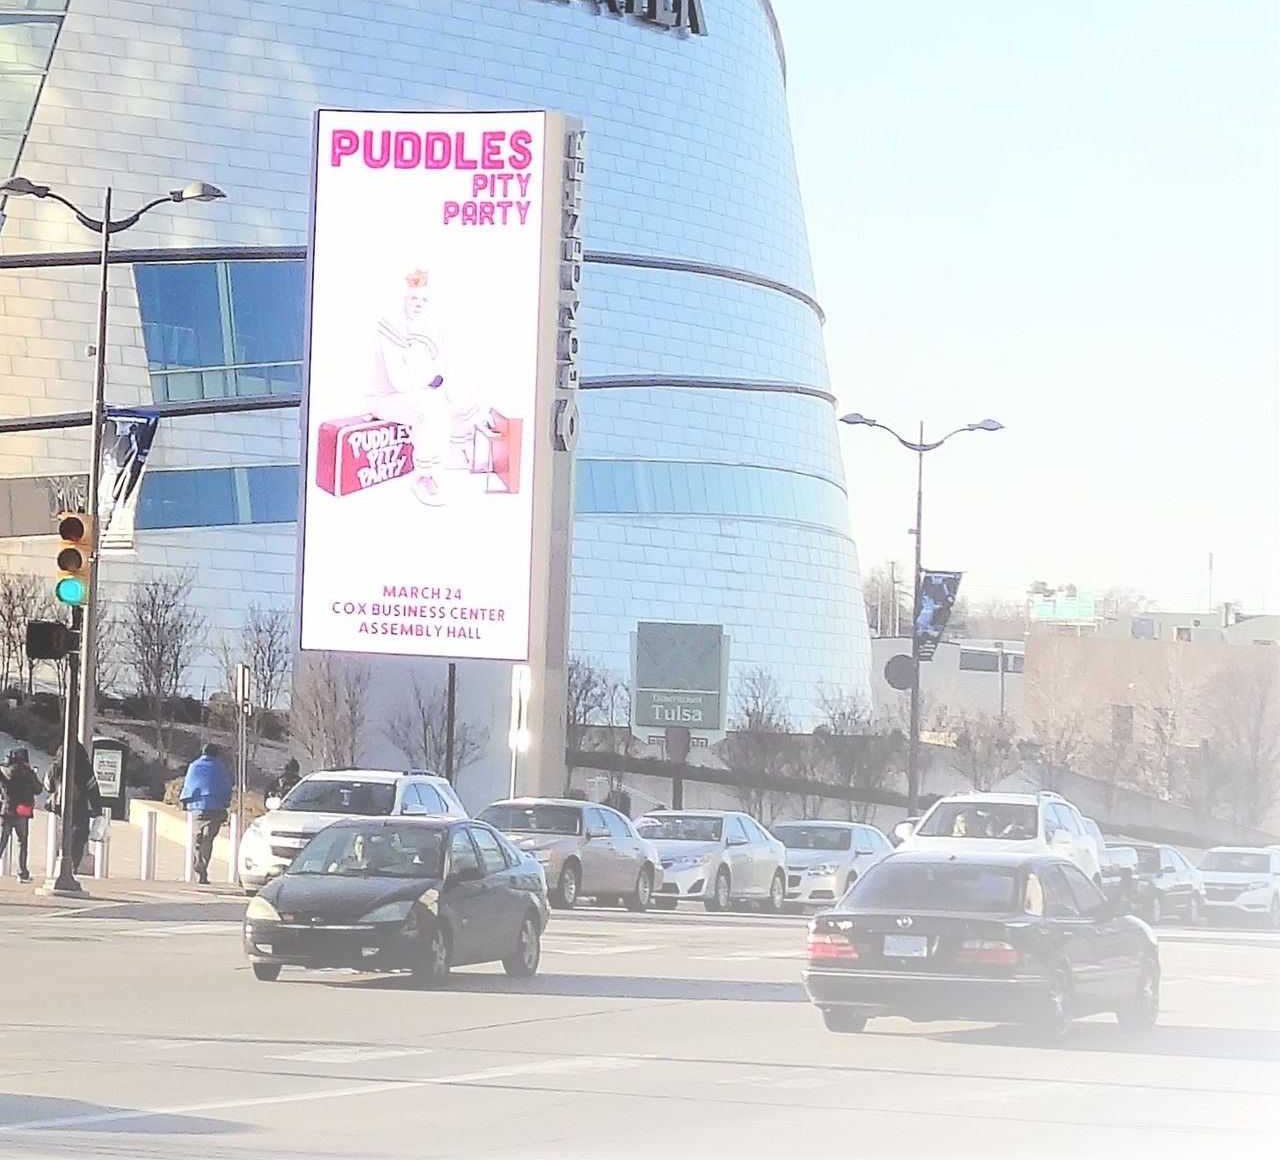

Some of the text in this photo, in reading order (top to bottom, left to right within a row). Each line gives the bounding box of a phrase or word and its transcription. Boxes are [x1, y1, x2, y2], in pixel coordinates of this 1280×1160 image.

[330, 129, 532, 170] PUDDLES
[472, 173, 531, 198] PITY
[443, 201, 531, 226] PARTY
[366, 444, 403, 469] PITY
[357, 454, 407, 488] PARTY
[382, 585, 462, 600] MARCH 24
[332, 601, 505, 622] COX BUSINESS CENTER
[359, 622, 481, 640] ASSEMBLY HALL
[651, 704, 703, 721] Tulsa
